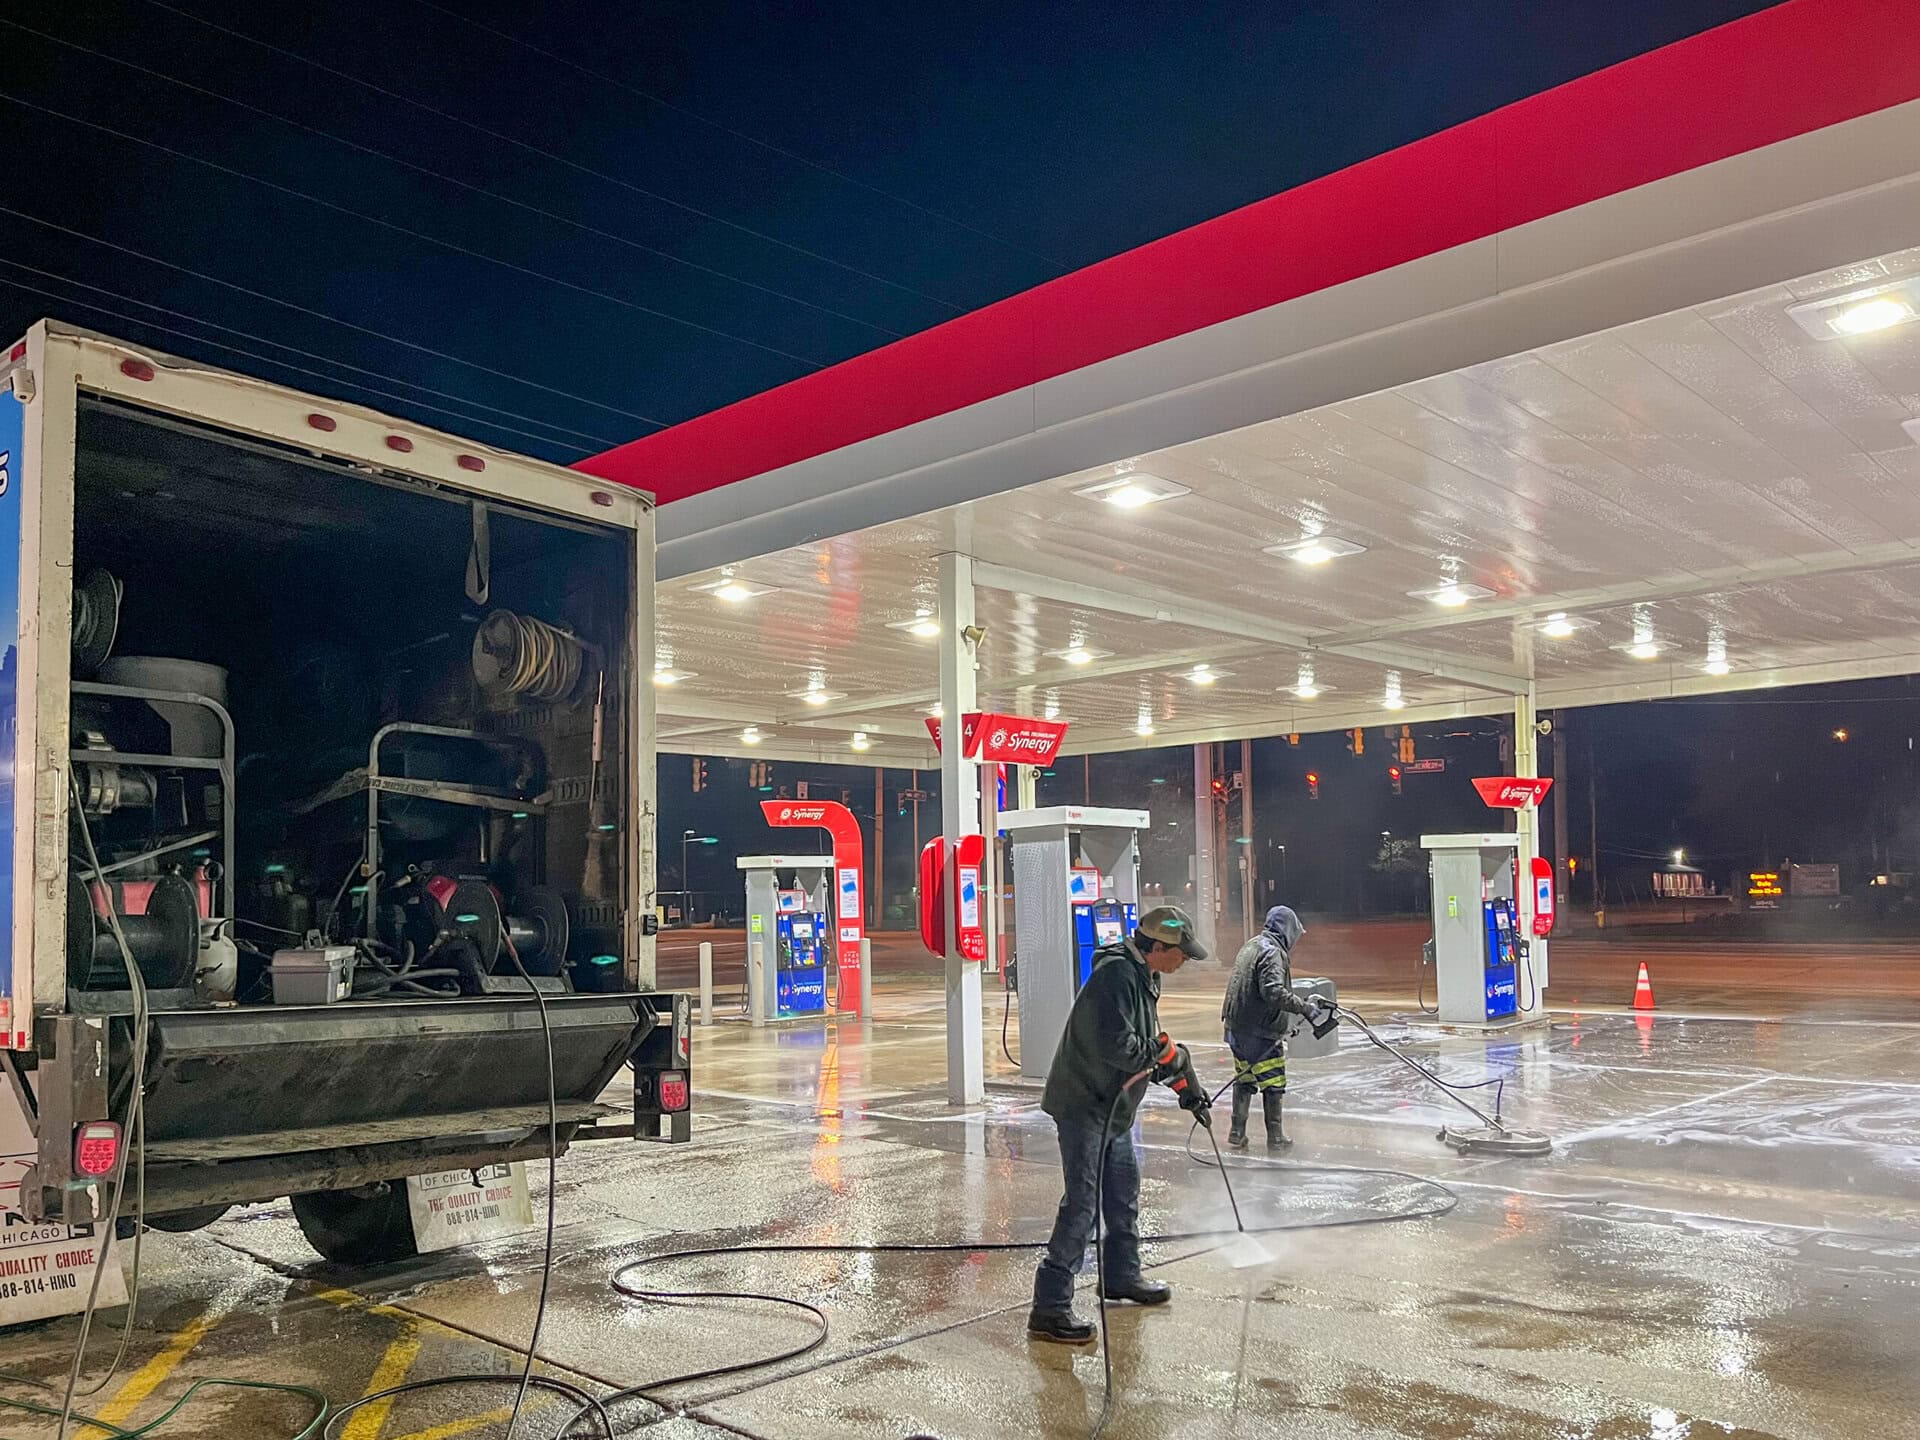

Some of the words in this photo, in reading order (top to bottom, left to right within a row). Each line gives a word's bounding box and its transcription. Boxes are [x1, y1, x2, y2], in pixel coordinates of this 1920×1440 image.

[935, 726, 942, 740] 3
[964, 723, 973, 737] 4
[1007, 733, 1054, 754] Synergy
[1534, 785, 1542, 794] 6
[792, 809, 825, 821] Synergy
[792, 984, 822, 996] Synergy
[1494, 983, 1515, 997] Synergy
[424, 1177, 437, 1187] OF
[447, 1192, 481, 1209] QUALITY
[485, 1186, 513, 1201] CHOICE
[0, 1227, 60, 1244] HICAGO
[56, 1248, 97, 1269] CHOICE
[0, 1273, 76, 1299] 88-814-HINO
